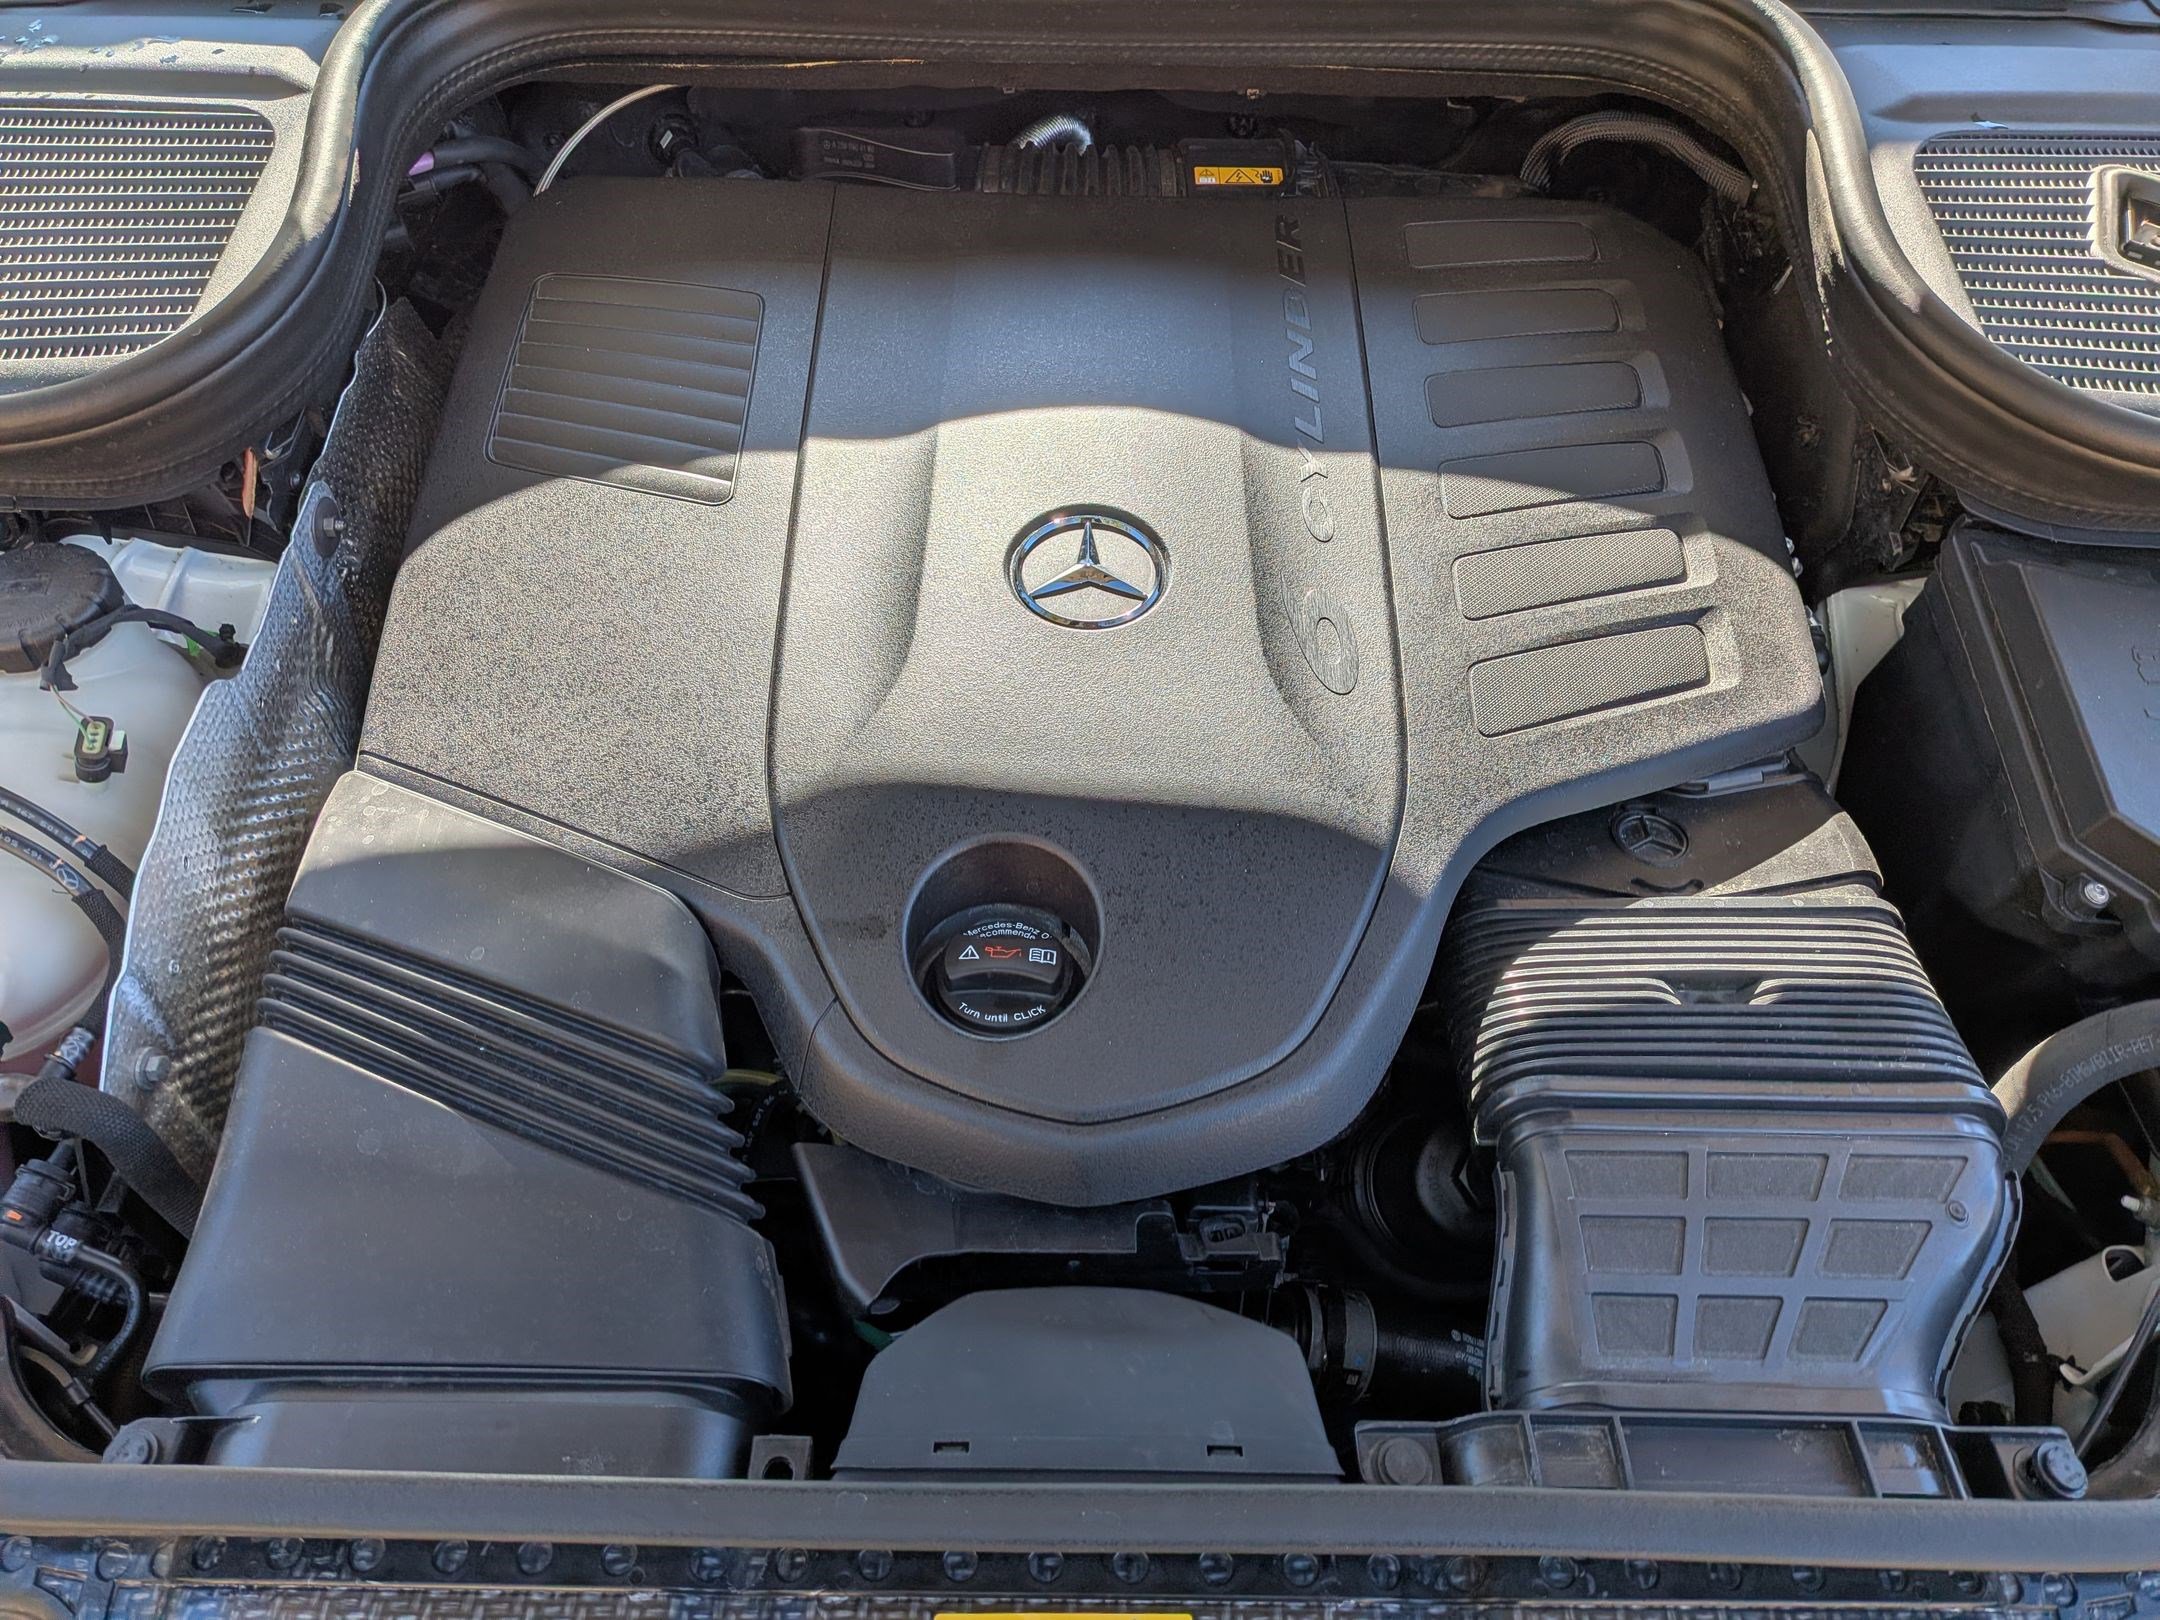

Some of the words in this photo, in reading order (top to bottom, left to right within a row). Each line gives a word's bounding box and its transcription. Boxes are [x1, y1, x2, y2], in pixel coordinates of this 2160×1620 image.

[1274, 213, 1336, 544] CYLINDER
[1280, 572, 1360, 697] 6
[963, 922, 1041, 937] Mercedes-Benz
[959, 1002, 981, 1019] Turn
[984, 1013, 1008, 1023] until
[1013, 1004, 1046, 1021] CLICK
[46, 1230, 79, 1249] TOP
